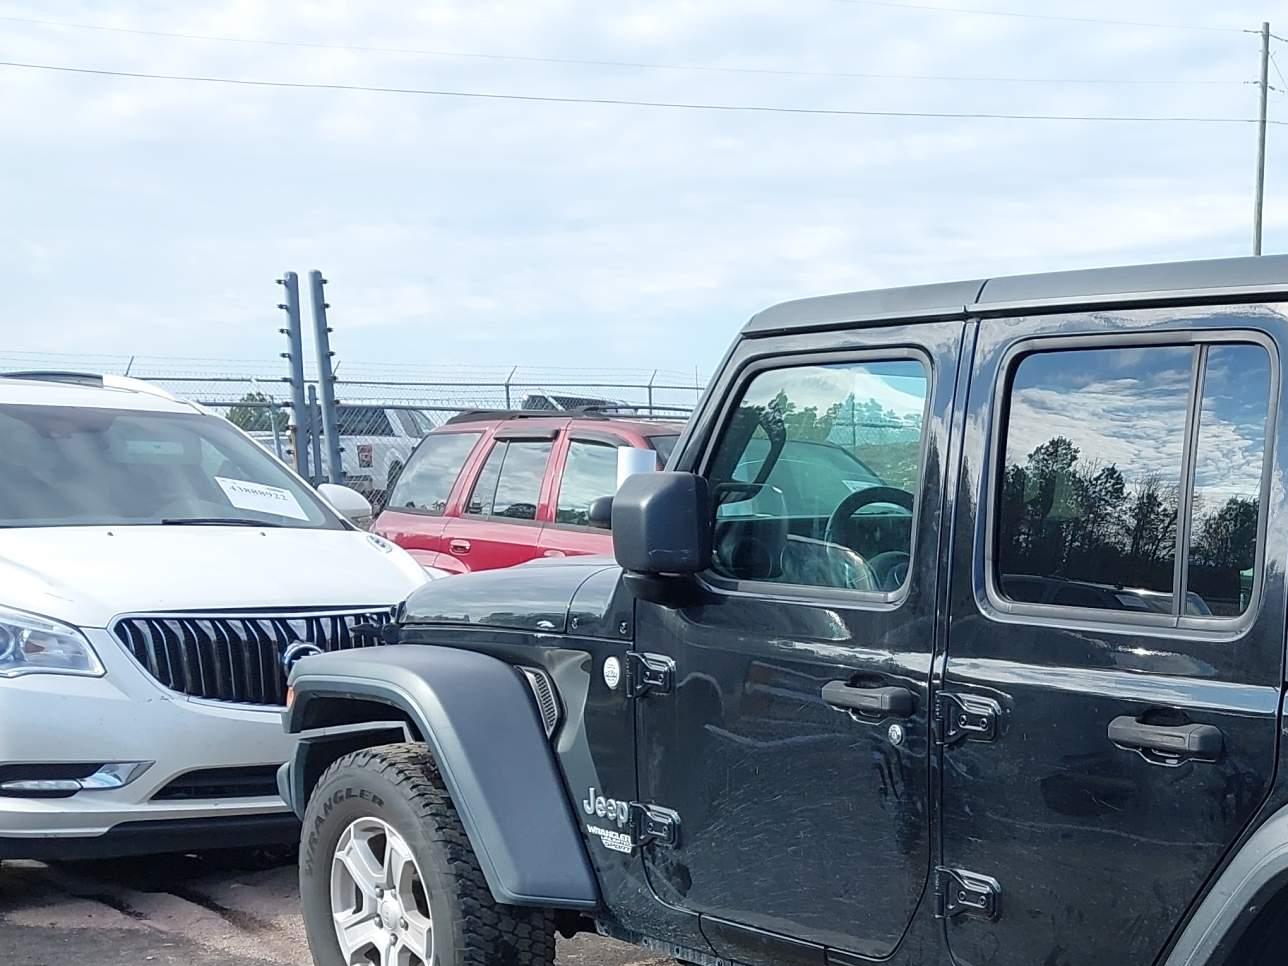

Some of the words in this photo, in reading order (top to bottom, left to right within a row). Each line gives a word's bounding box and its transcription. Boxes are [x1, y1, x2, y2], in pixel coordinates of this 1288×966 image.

[583, 787, 629, 828] Jeep
[303, 786, 385, 878] WRANGLER
[586, 823, 632, 842] WRANGLER
